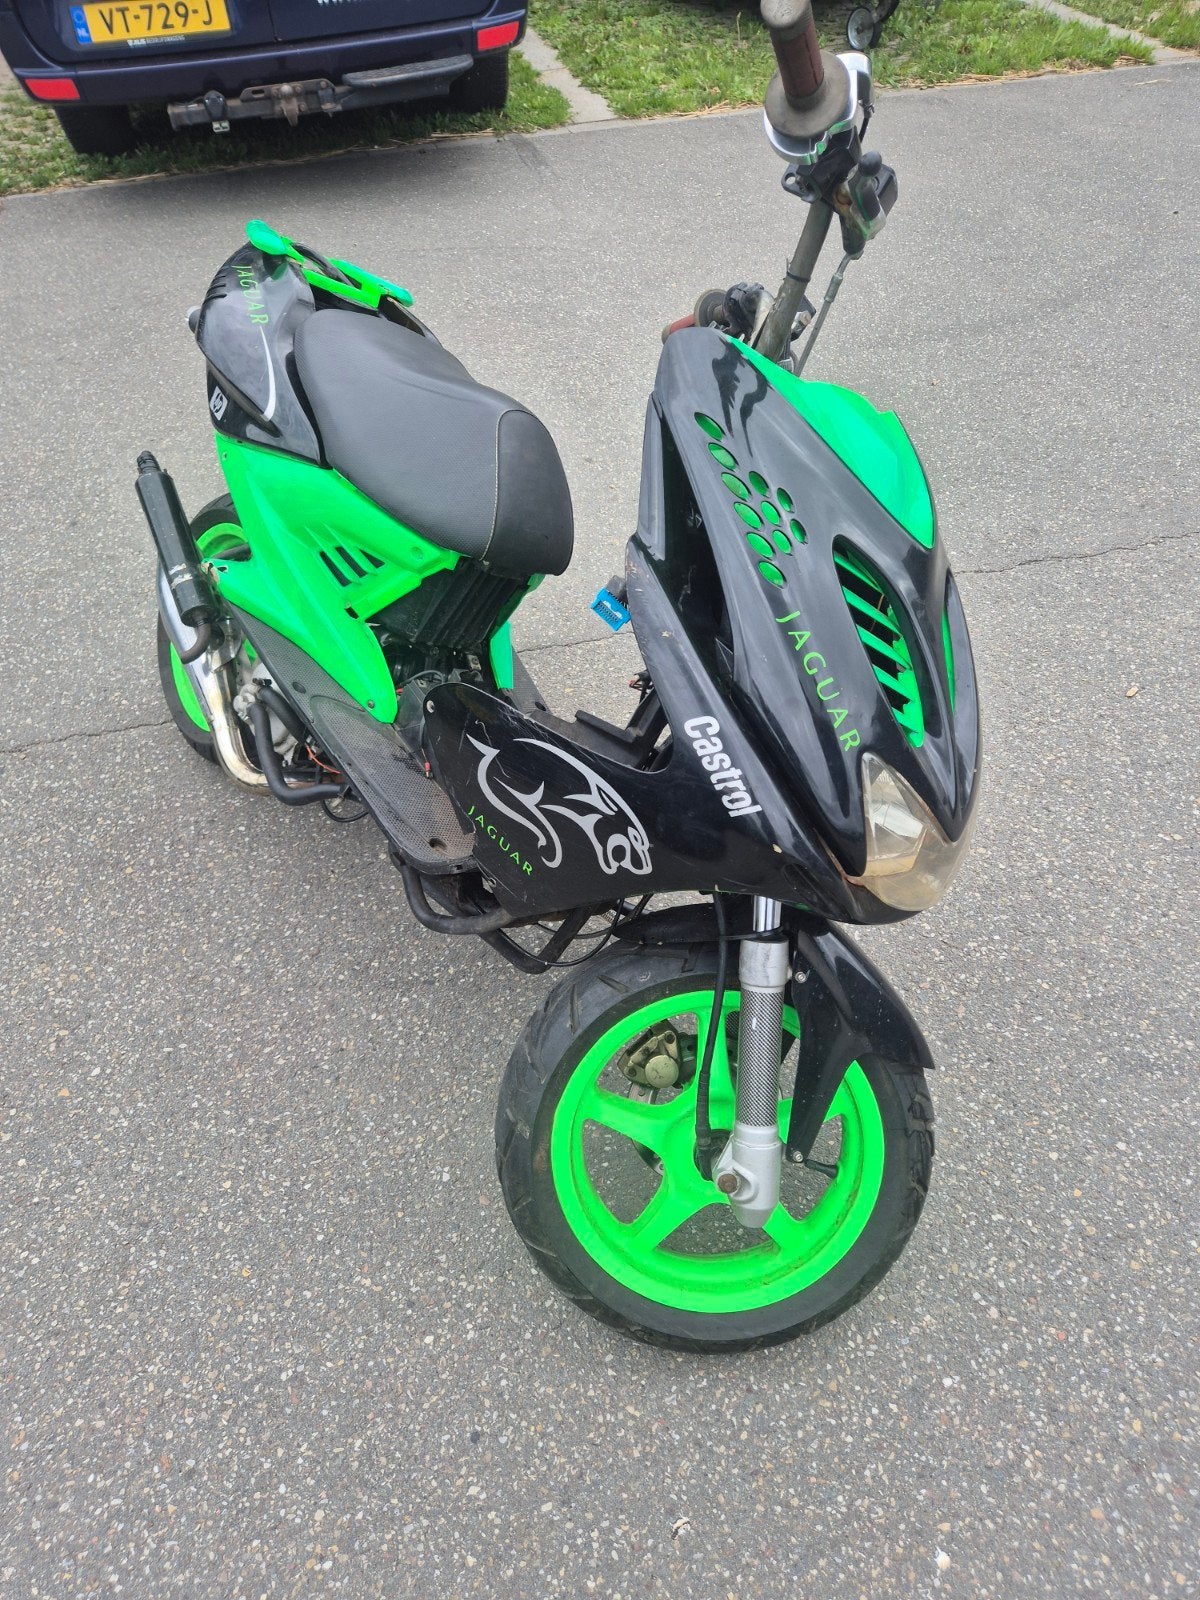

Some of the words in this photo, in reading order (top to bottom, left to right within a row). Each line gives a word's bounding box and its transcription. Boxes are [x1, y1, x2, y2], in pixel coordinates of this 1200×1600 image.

[98, 0, 213, 35] VT-729-J
[231, 264, 270, 325] JAGUAR
[775, 610, 861, 752] JAGUAR
[683, 715, 763, 818] Castrol
[467, 805, 534, 876] JAGUAR
